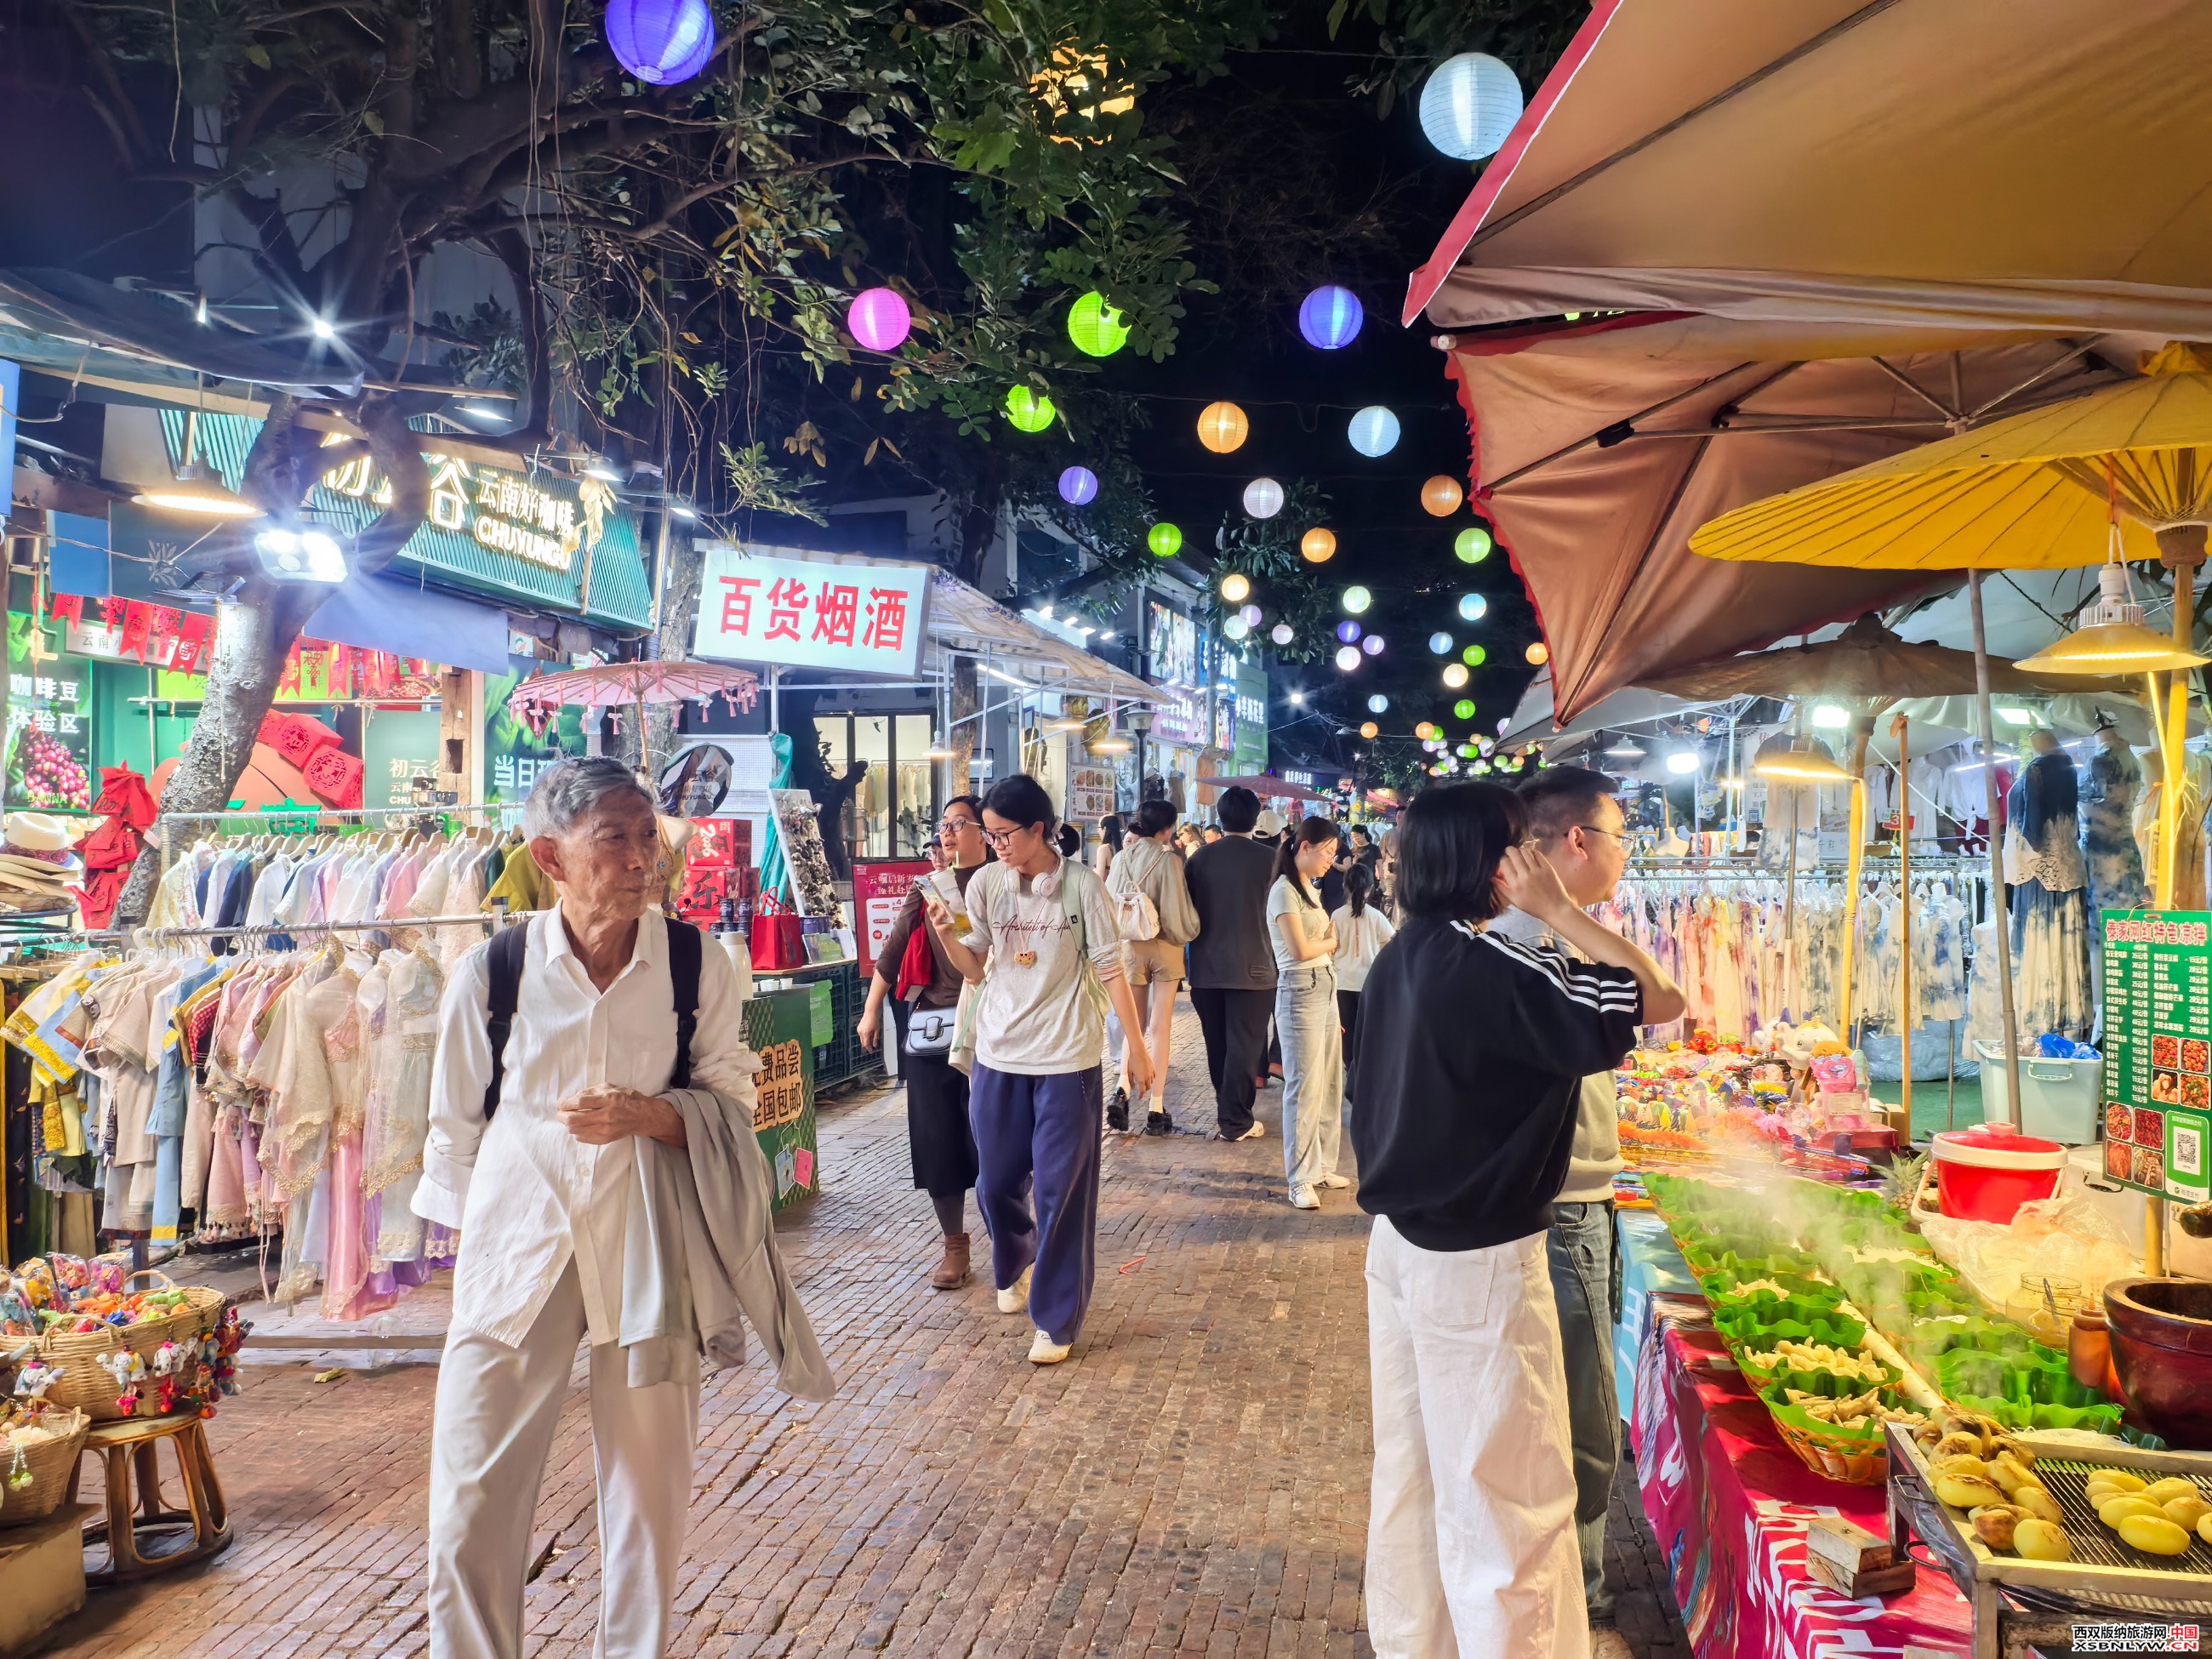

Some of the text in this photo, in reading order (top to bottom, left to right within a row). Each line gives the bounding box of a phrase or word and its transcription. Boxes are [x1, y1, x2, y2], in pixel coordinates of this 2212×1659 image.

[719, 575, 909, 652] 百货烟酒
[9, 673, 81, 703] 咖啡豆
[8, 710, 81, 734] 体验区
[2106, 919, 2207, 945] 傣家网红特色凉拌
